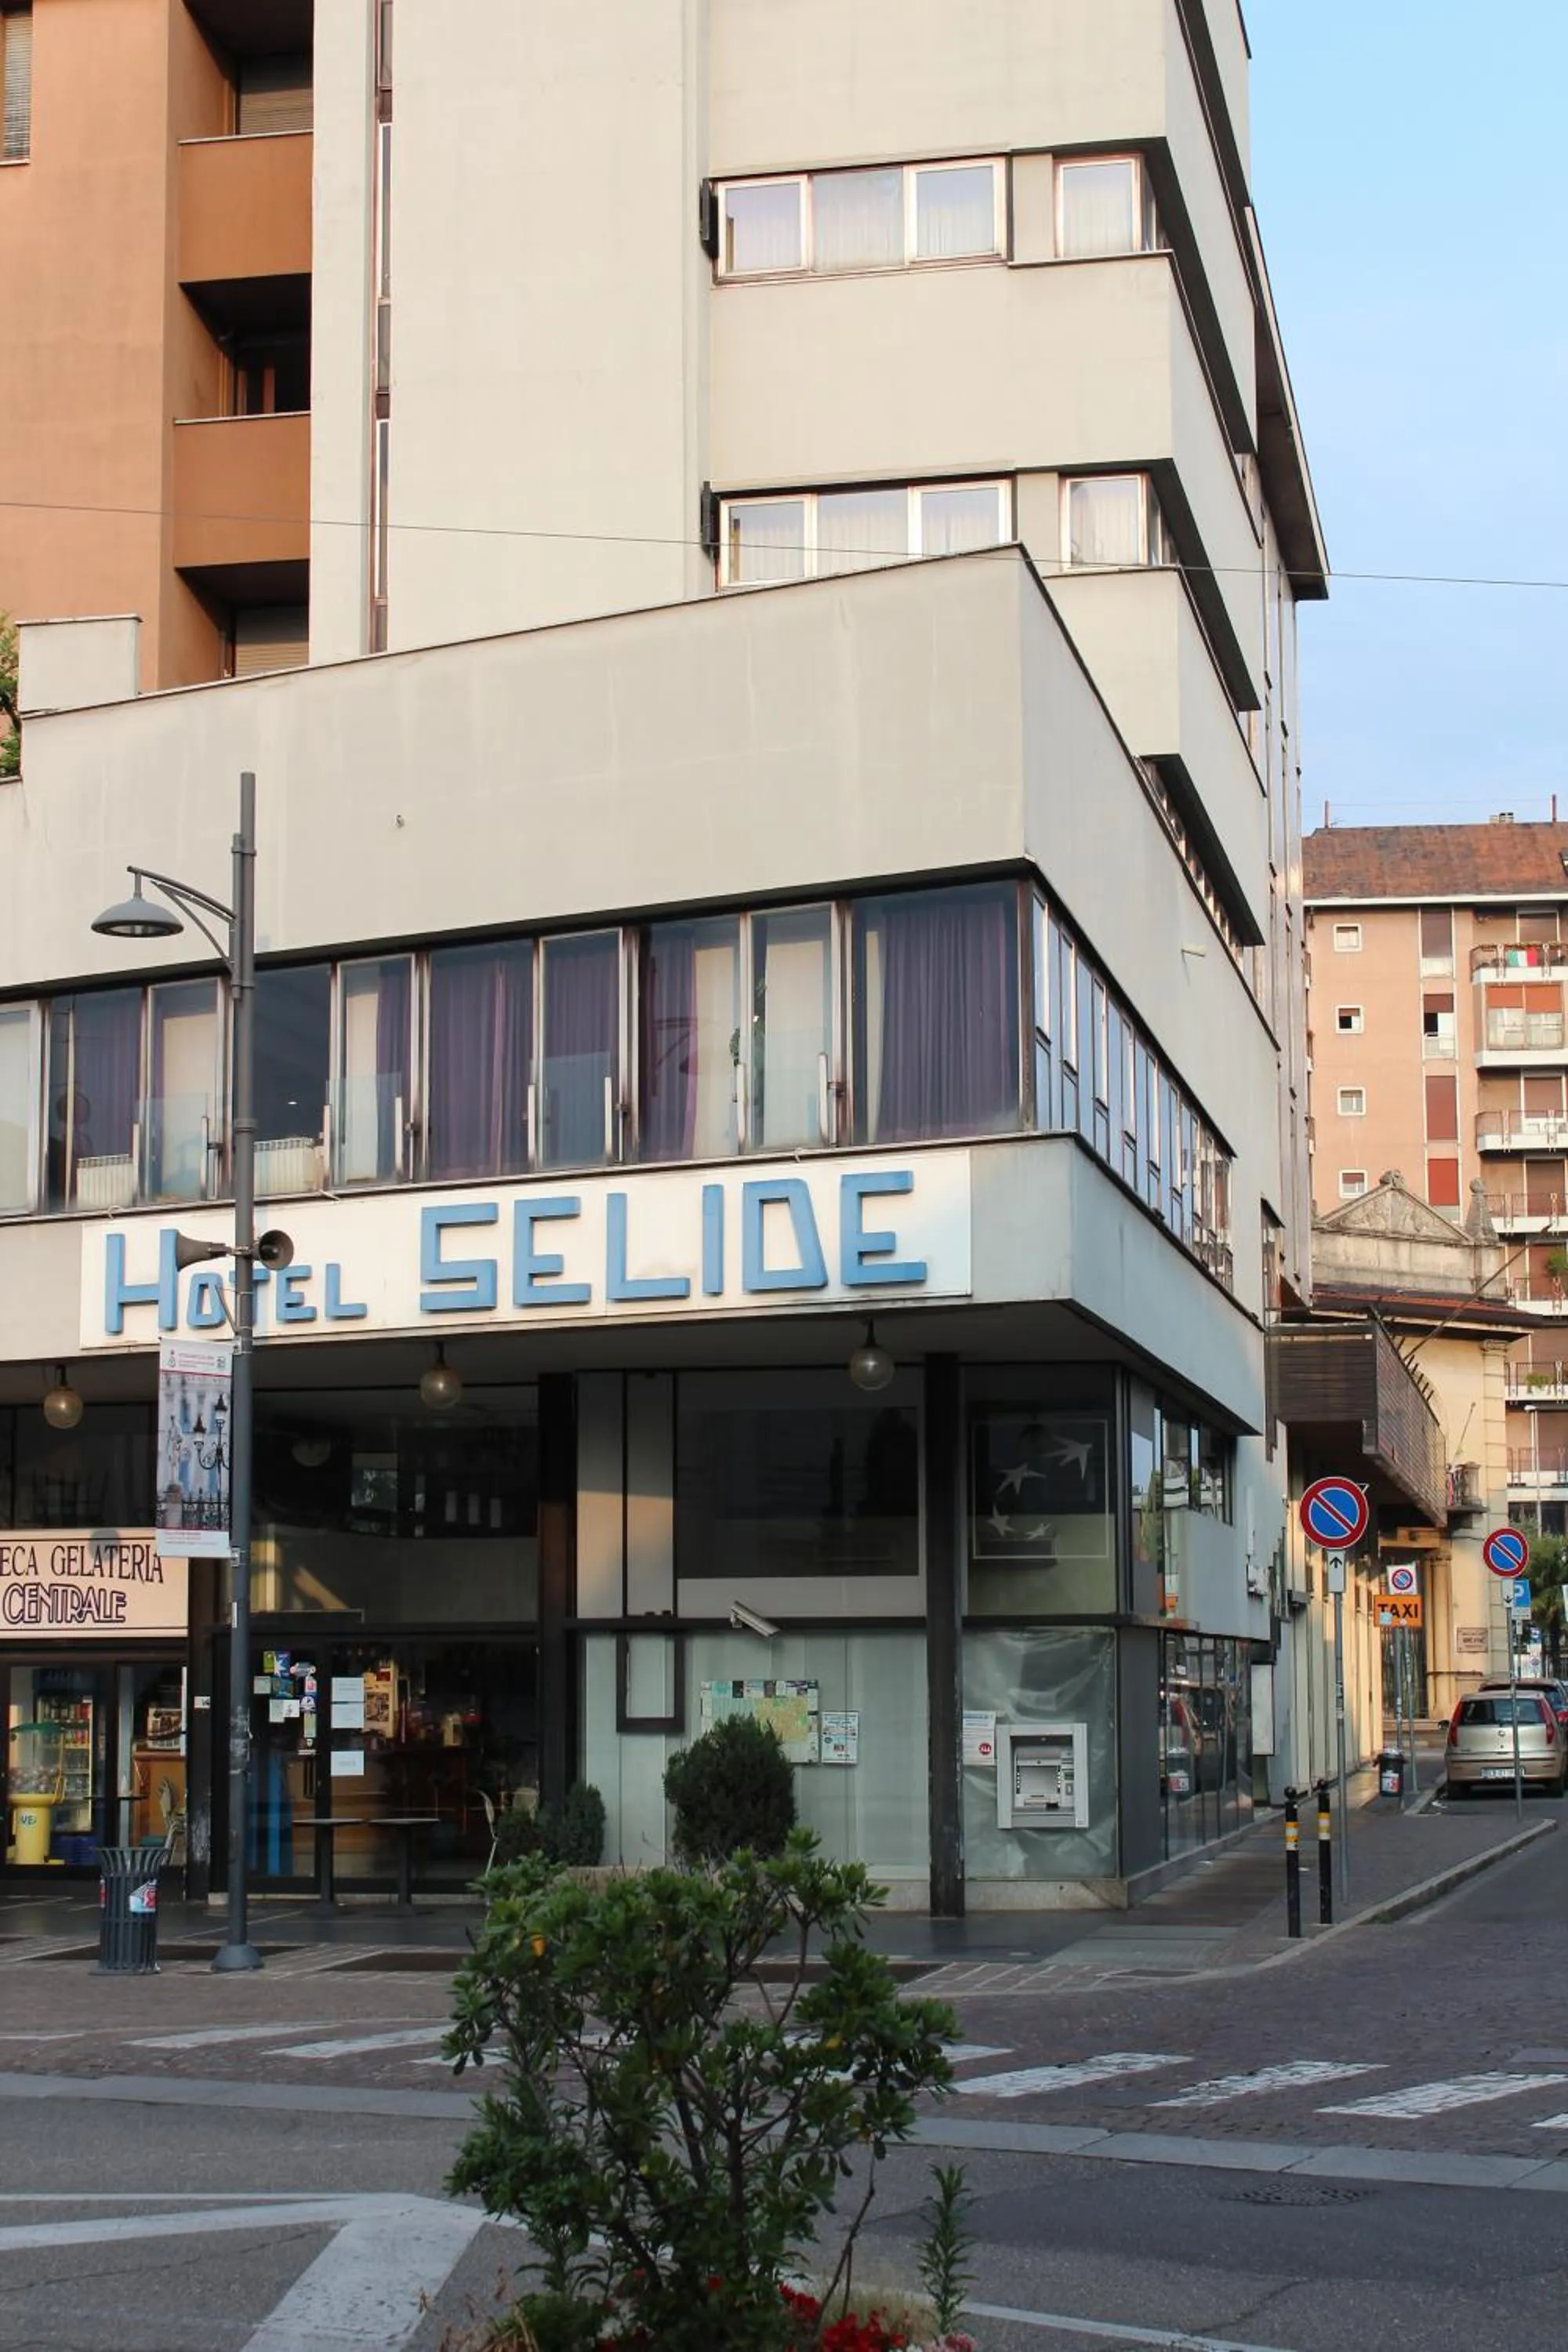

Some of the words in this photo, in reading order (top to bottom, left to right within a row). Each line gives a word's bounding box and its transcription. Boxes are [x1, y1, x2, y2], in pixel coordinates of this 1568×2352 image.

[419, 1170, 927, 1312] SELIDE
[50, 1544, 164, 1584] GELATERIA
[3, 1582, 127, 1624] CENTRALE
[1377, 1603, 1418, 1618] TAXI
